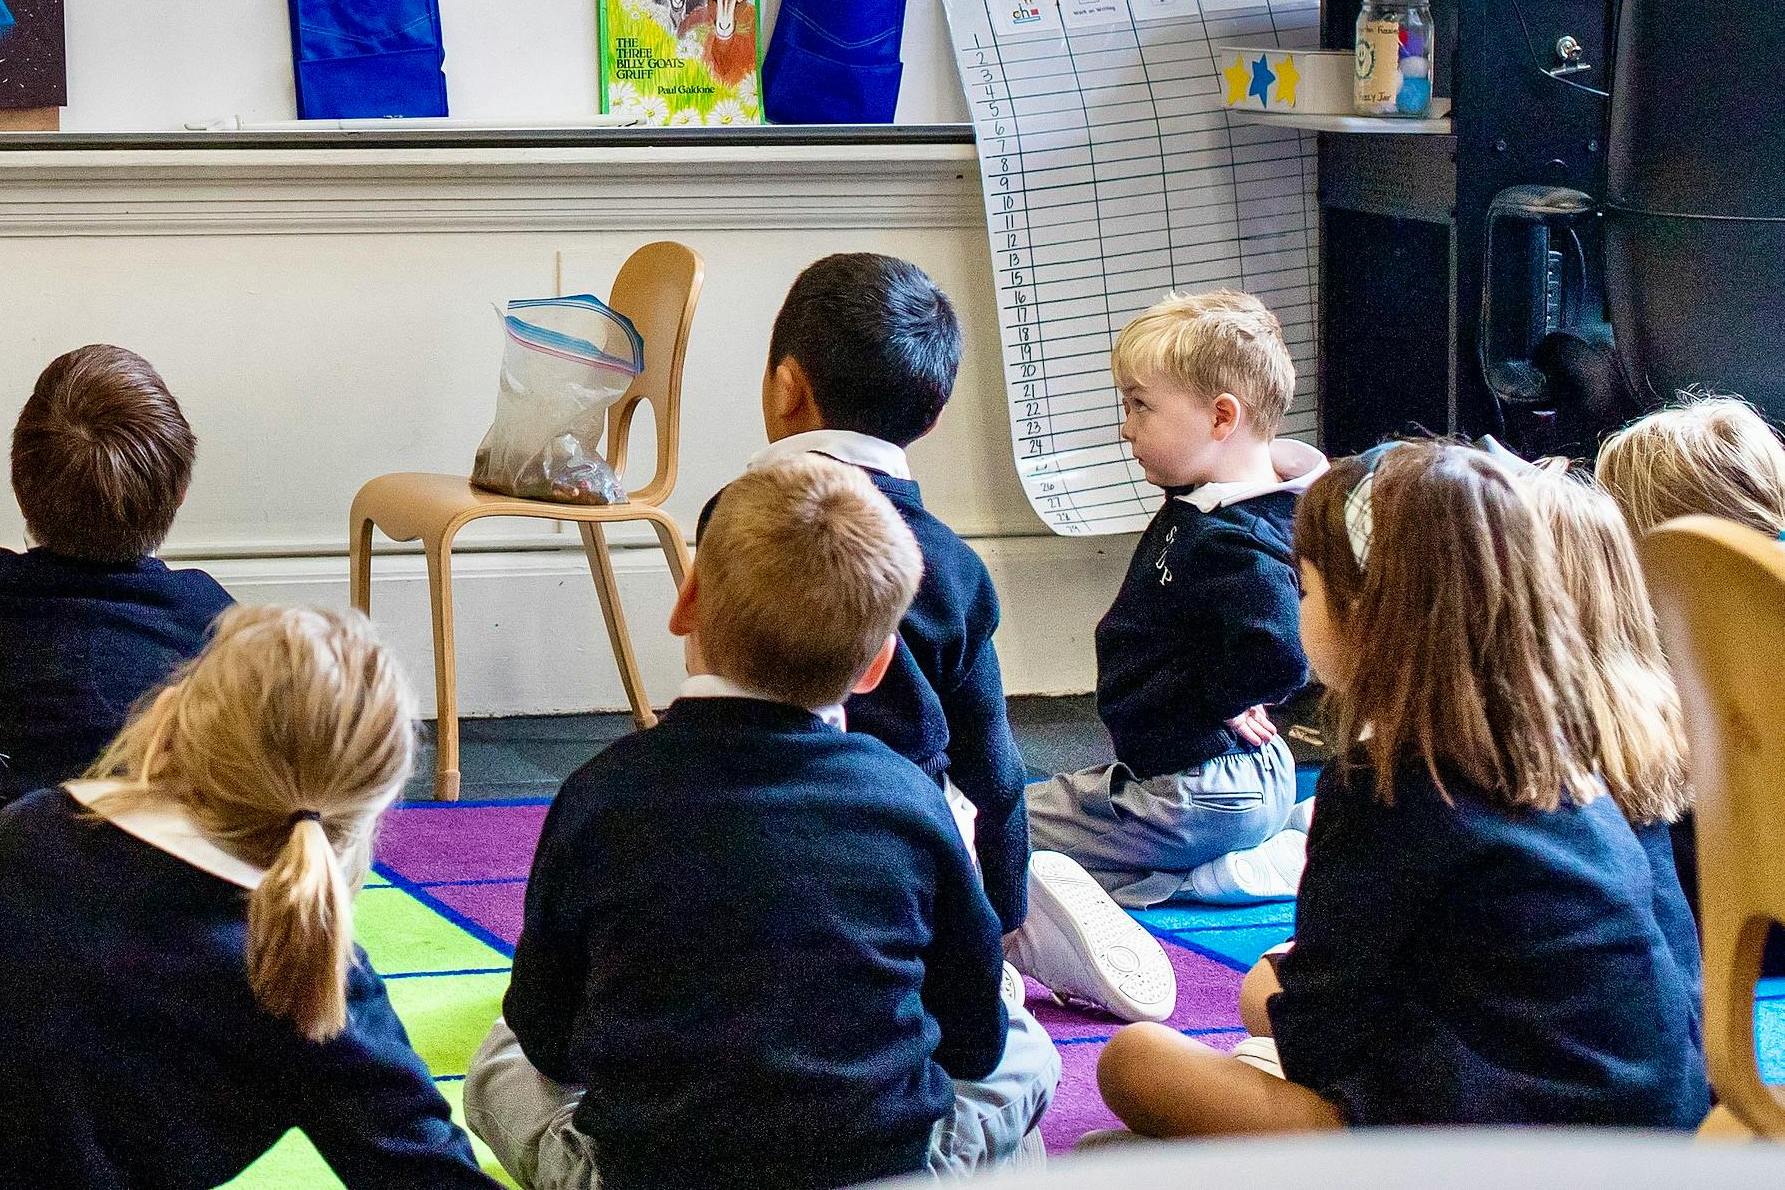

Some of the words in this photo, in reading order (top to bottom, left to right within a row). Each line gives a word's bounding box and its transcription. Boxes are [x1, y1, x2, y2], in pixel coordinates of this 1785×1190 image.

[616, 37, 639, 48] THE
[616, 48, 652, 59] THREE
[616, 58, 644, 69] BILLY
[647, 58, 685, 69] GOATS
[616, 69, 654, 80] GRUFF
[657, 85, 677, 95] Paul
[677, 84, 715, 95] Galdone
[988, 101, 999, 117] 5
[1003, 195, 1014, 210] 10
[1009, 253, 1020, 267] 13
[1018, 327, 1030, 342] 18
[1026, 402, 1041, 417] 22
